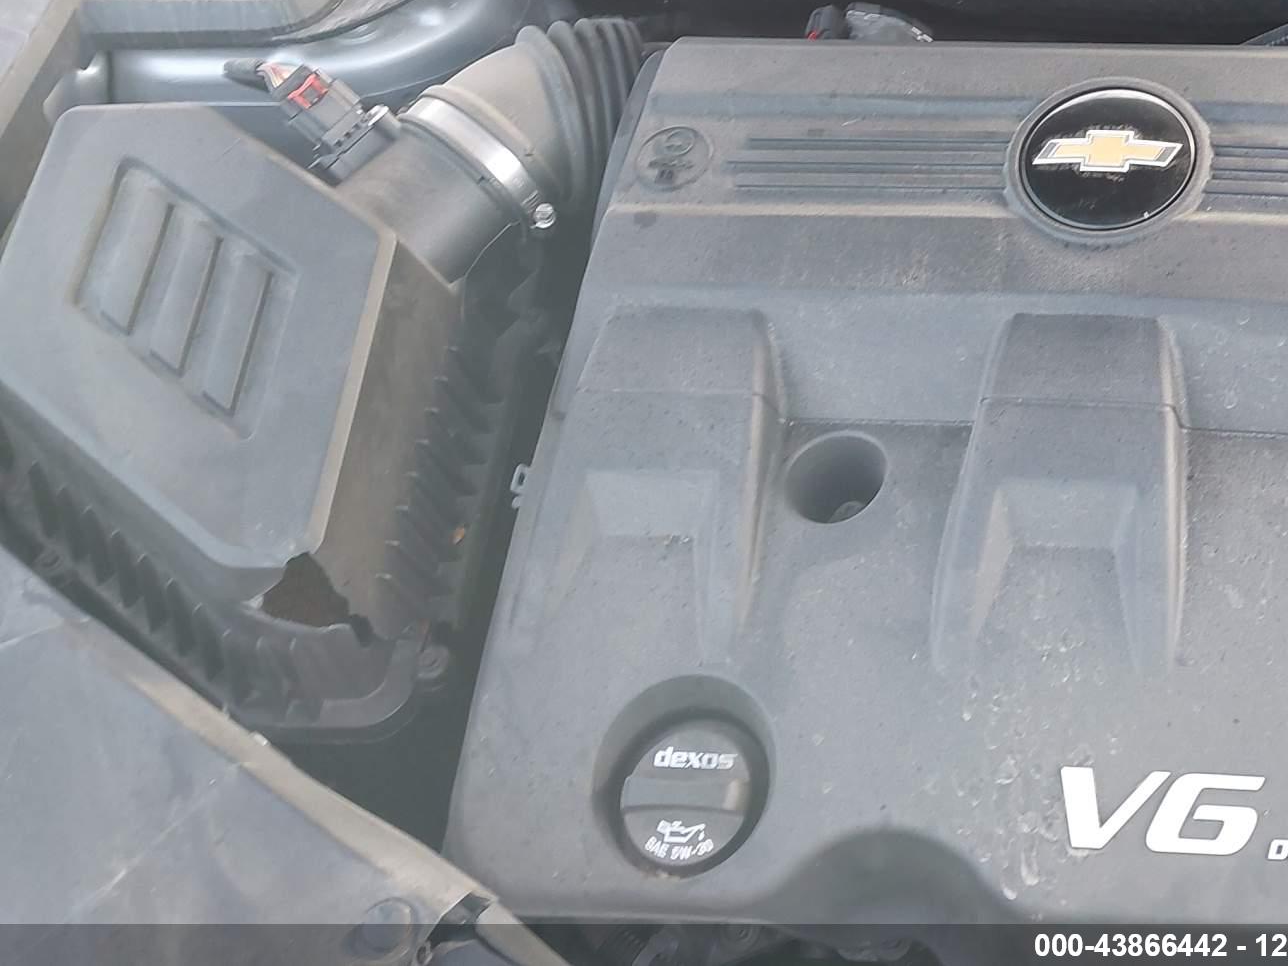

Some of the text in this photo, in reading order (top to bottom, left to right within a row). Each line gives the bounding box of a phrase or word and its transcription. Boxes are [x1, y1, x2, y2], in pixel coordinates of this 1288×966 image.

[653, 746, 738, 770] dexos
[1060, 766, 1266, 855] V6
[645, 836, 670, 858] SAE
